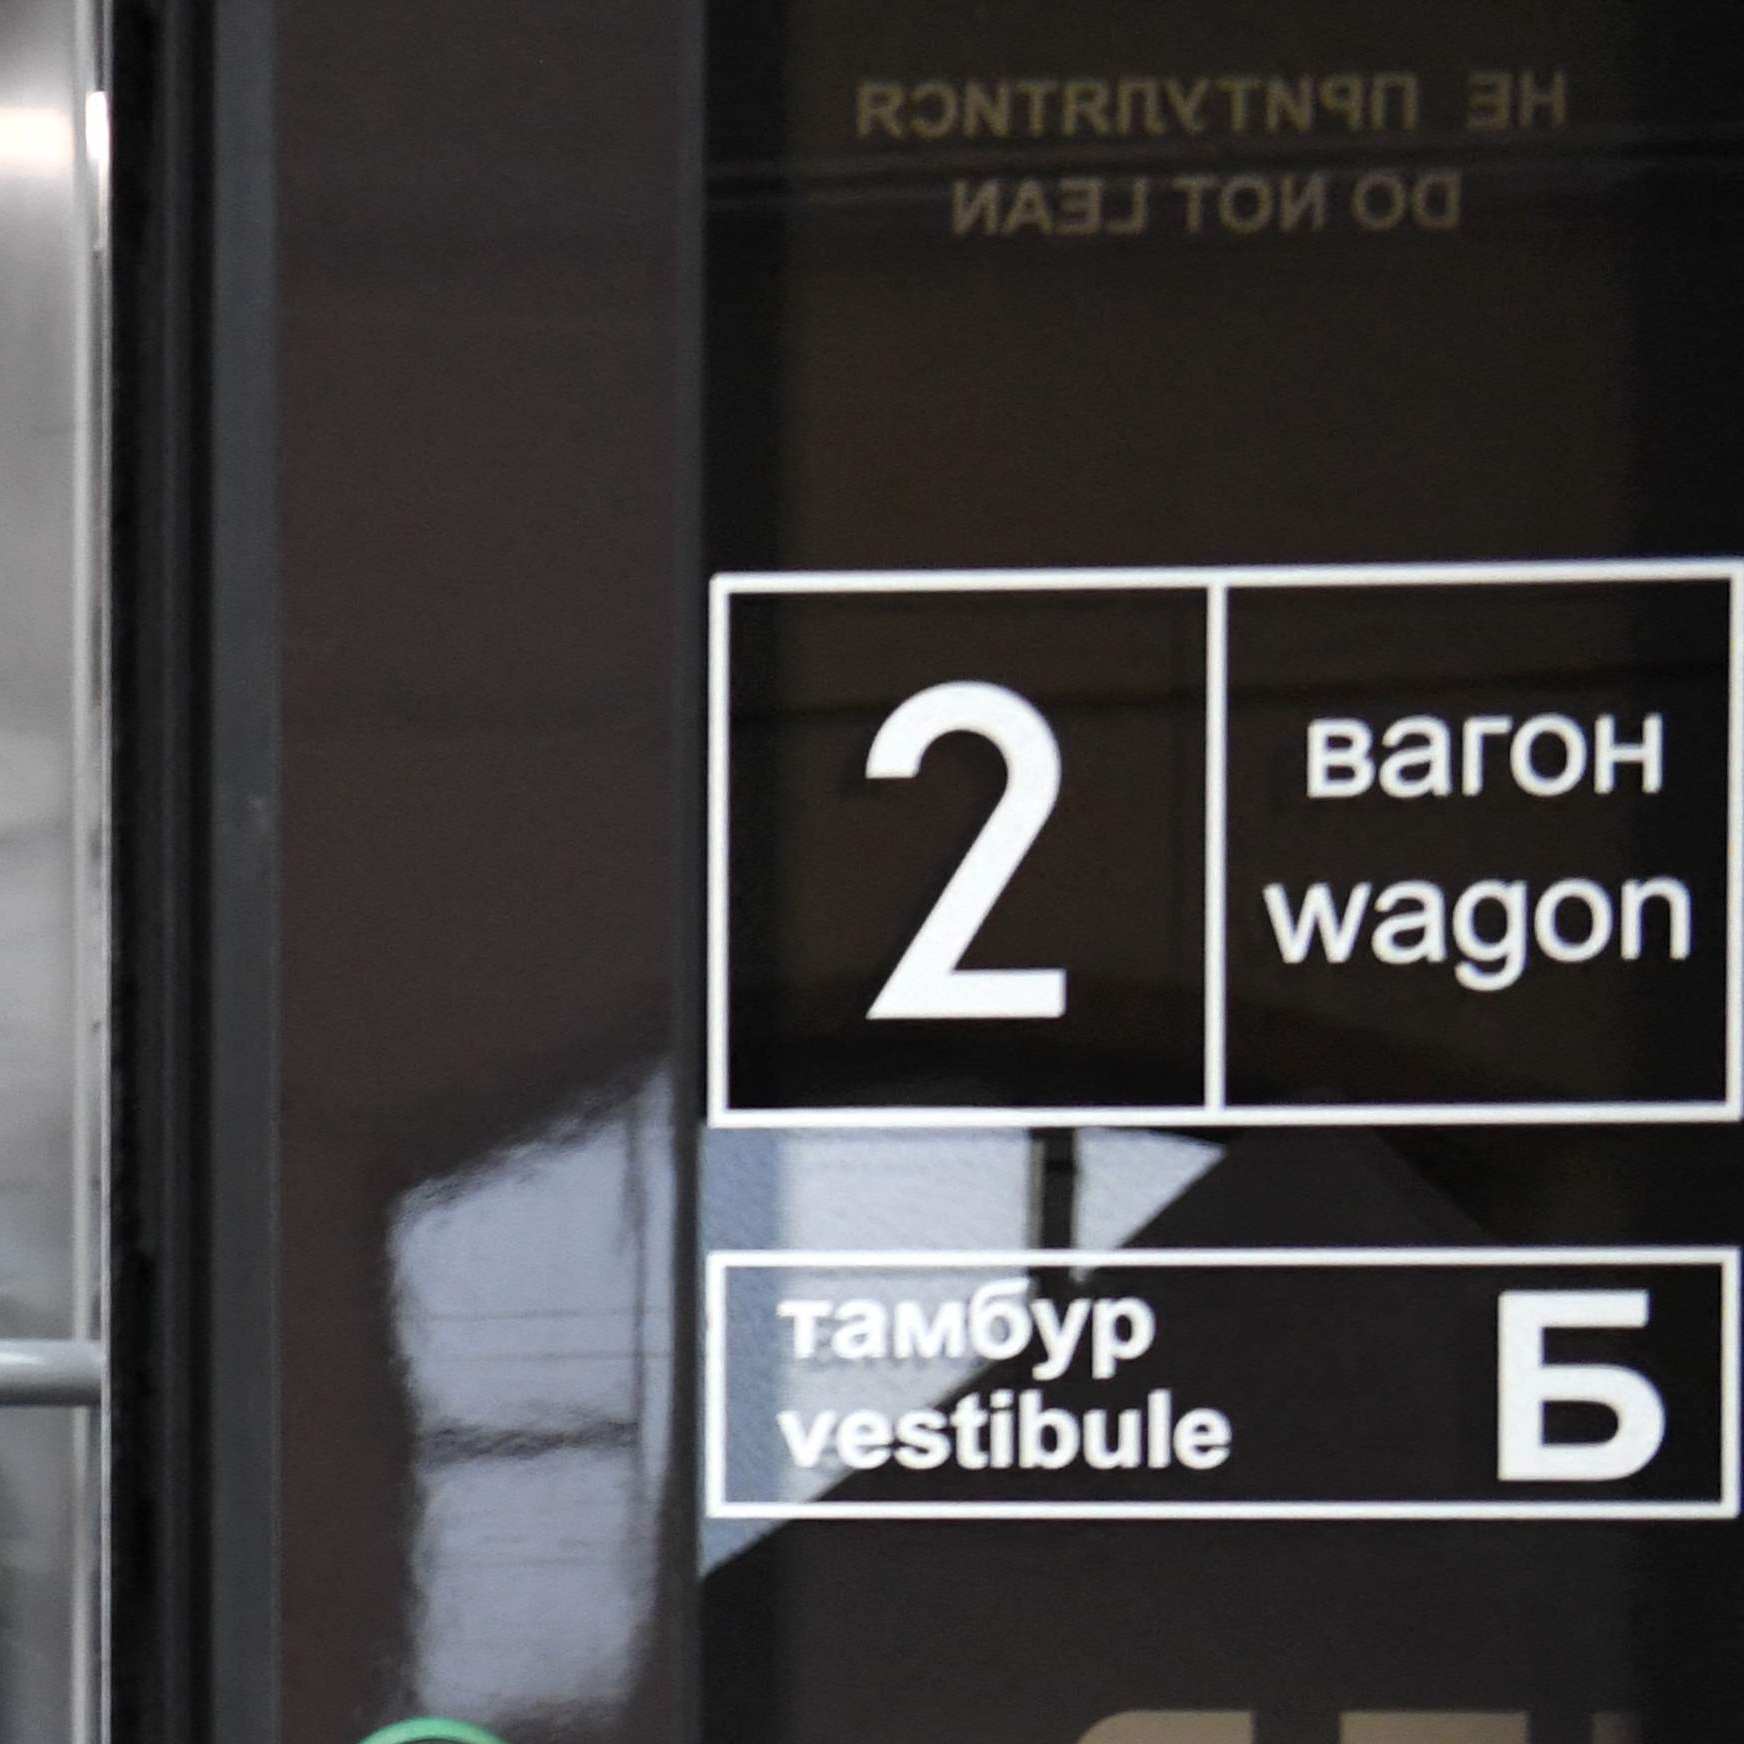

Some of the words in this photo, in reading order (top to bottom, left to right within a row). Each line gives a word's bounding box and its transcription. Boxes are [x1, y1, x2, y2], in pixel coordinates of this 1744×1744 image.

[1307, 714, 1663, 798] вагон
[867, 683, 1064, 1018] 2
[1263, 878, 1690, 991] wagon
[778, 1280, 1155, 1378] тамбур
[779, 1392, 1231, 1469] vestibule
[1498, 1290, 1665, 1481] Б
